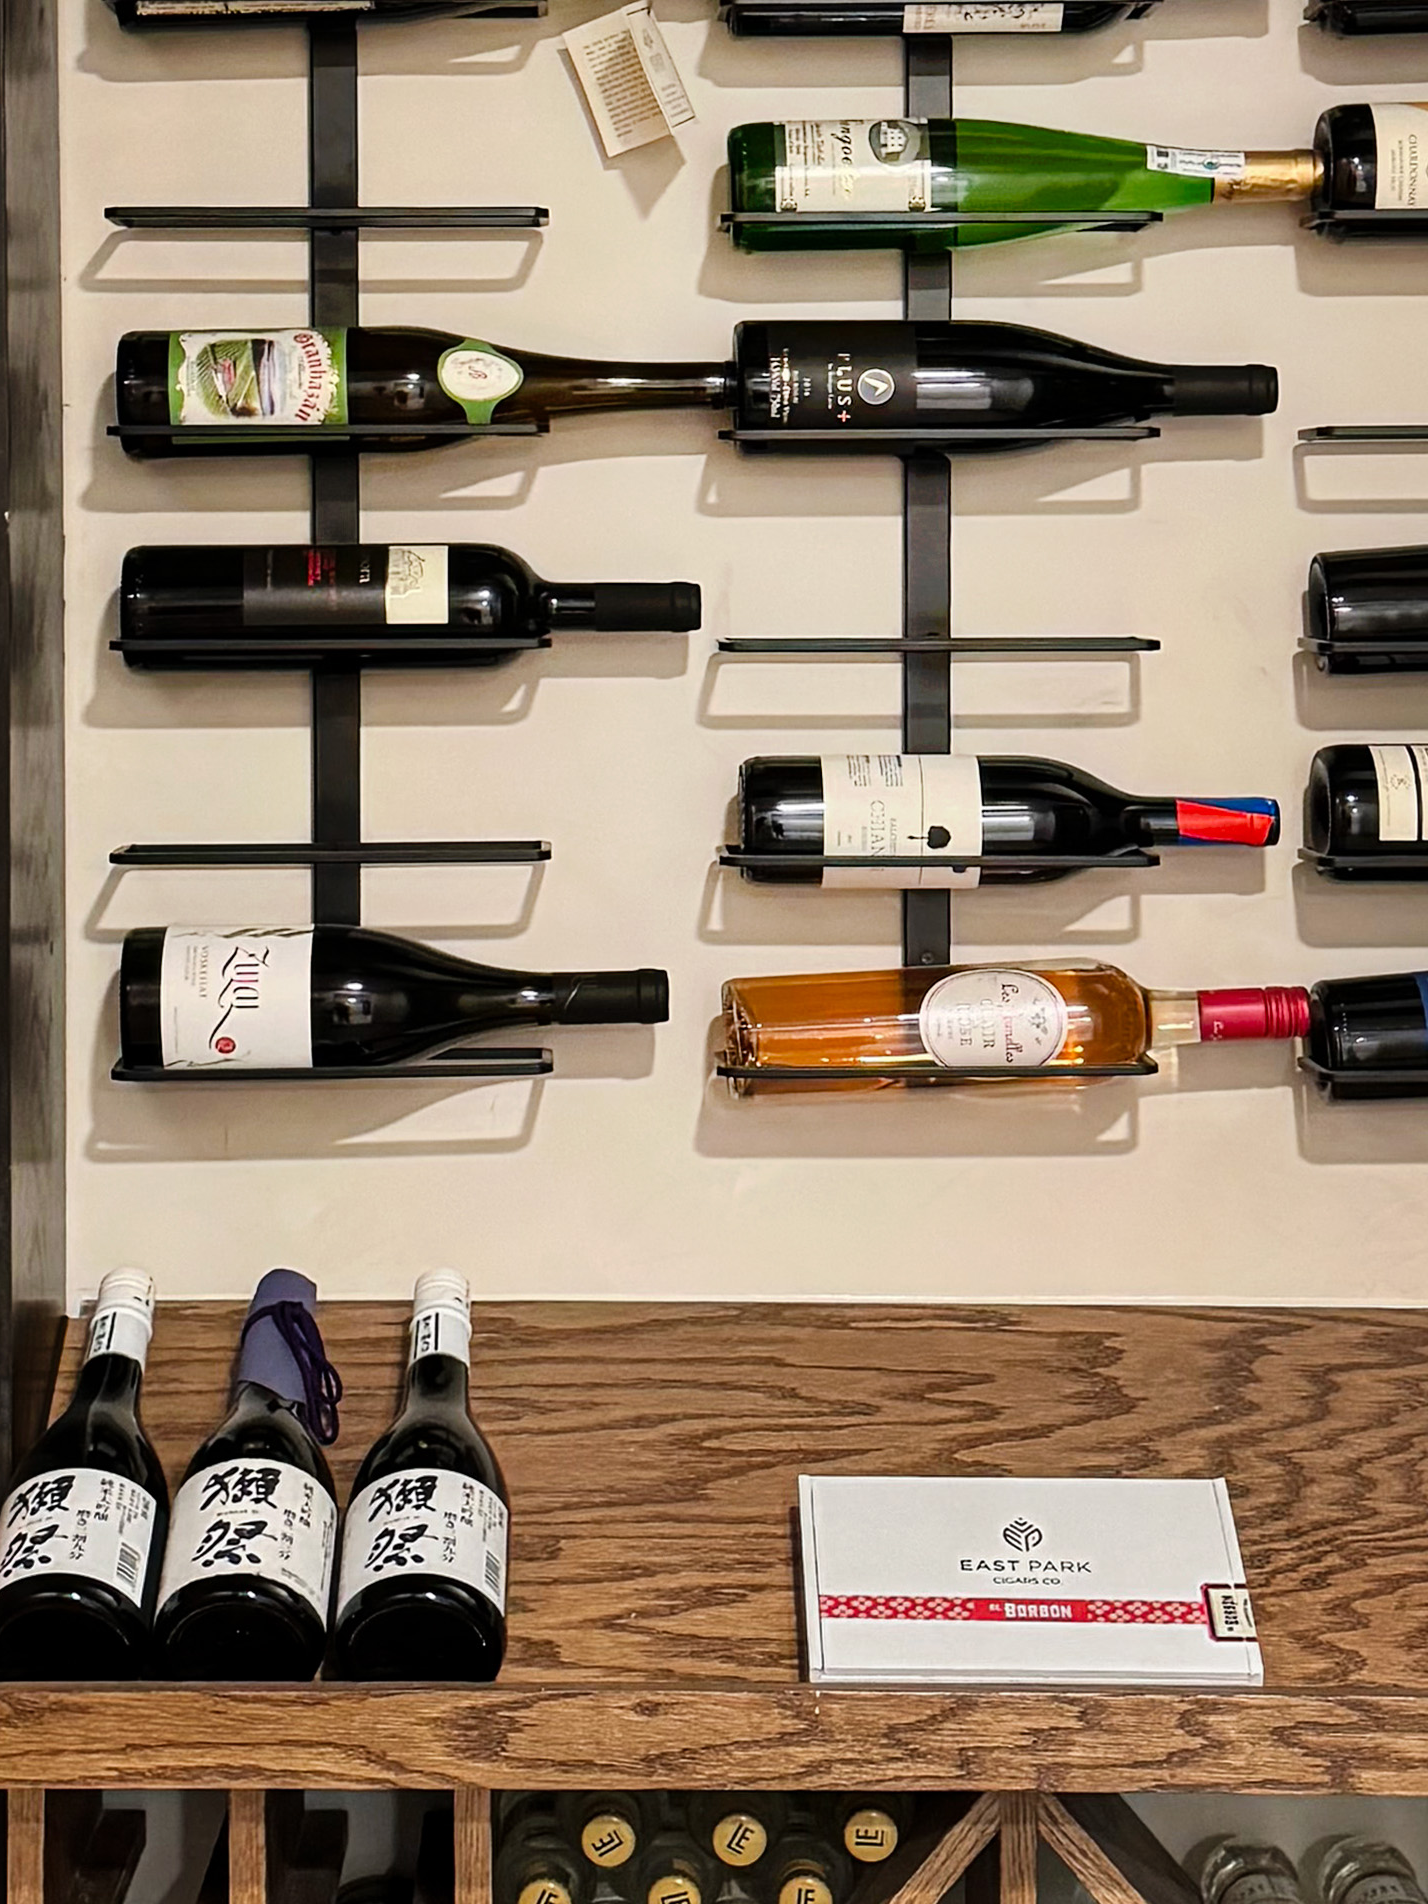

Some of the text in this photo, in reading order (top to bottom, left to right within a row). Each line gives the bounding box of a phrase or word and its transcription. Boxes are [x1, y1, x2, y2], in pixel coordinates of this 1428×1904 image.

[960, 1559, 1091, 1573] EAST PARK
[993, 1577, 1039, 1585] CIGARS
[1004, 1602, 1073, 1619] BORBON
